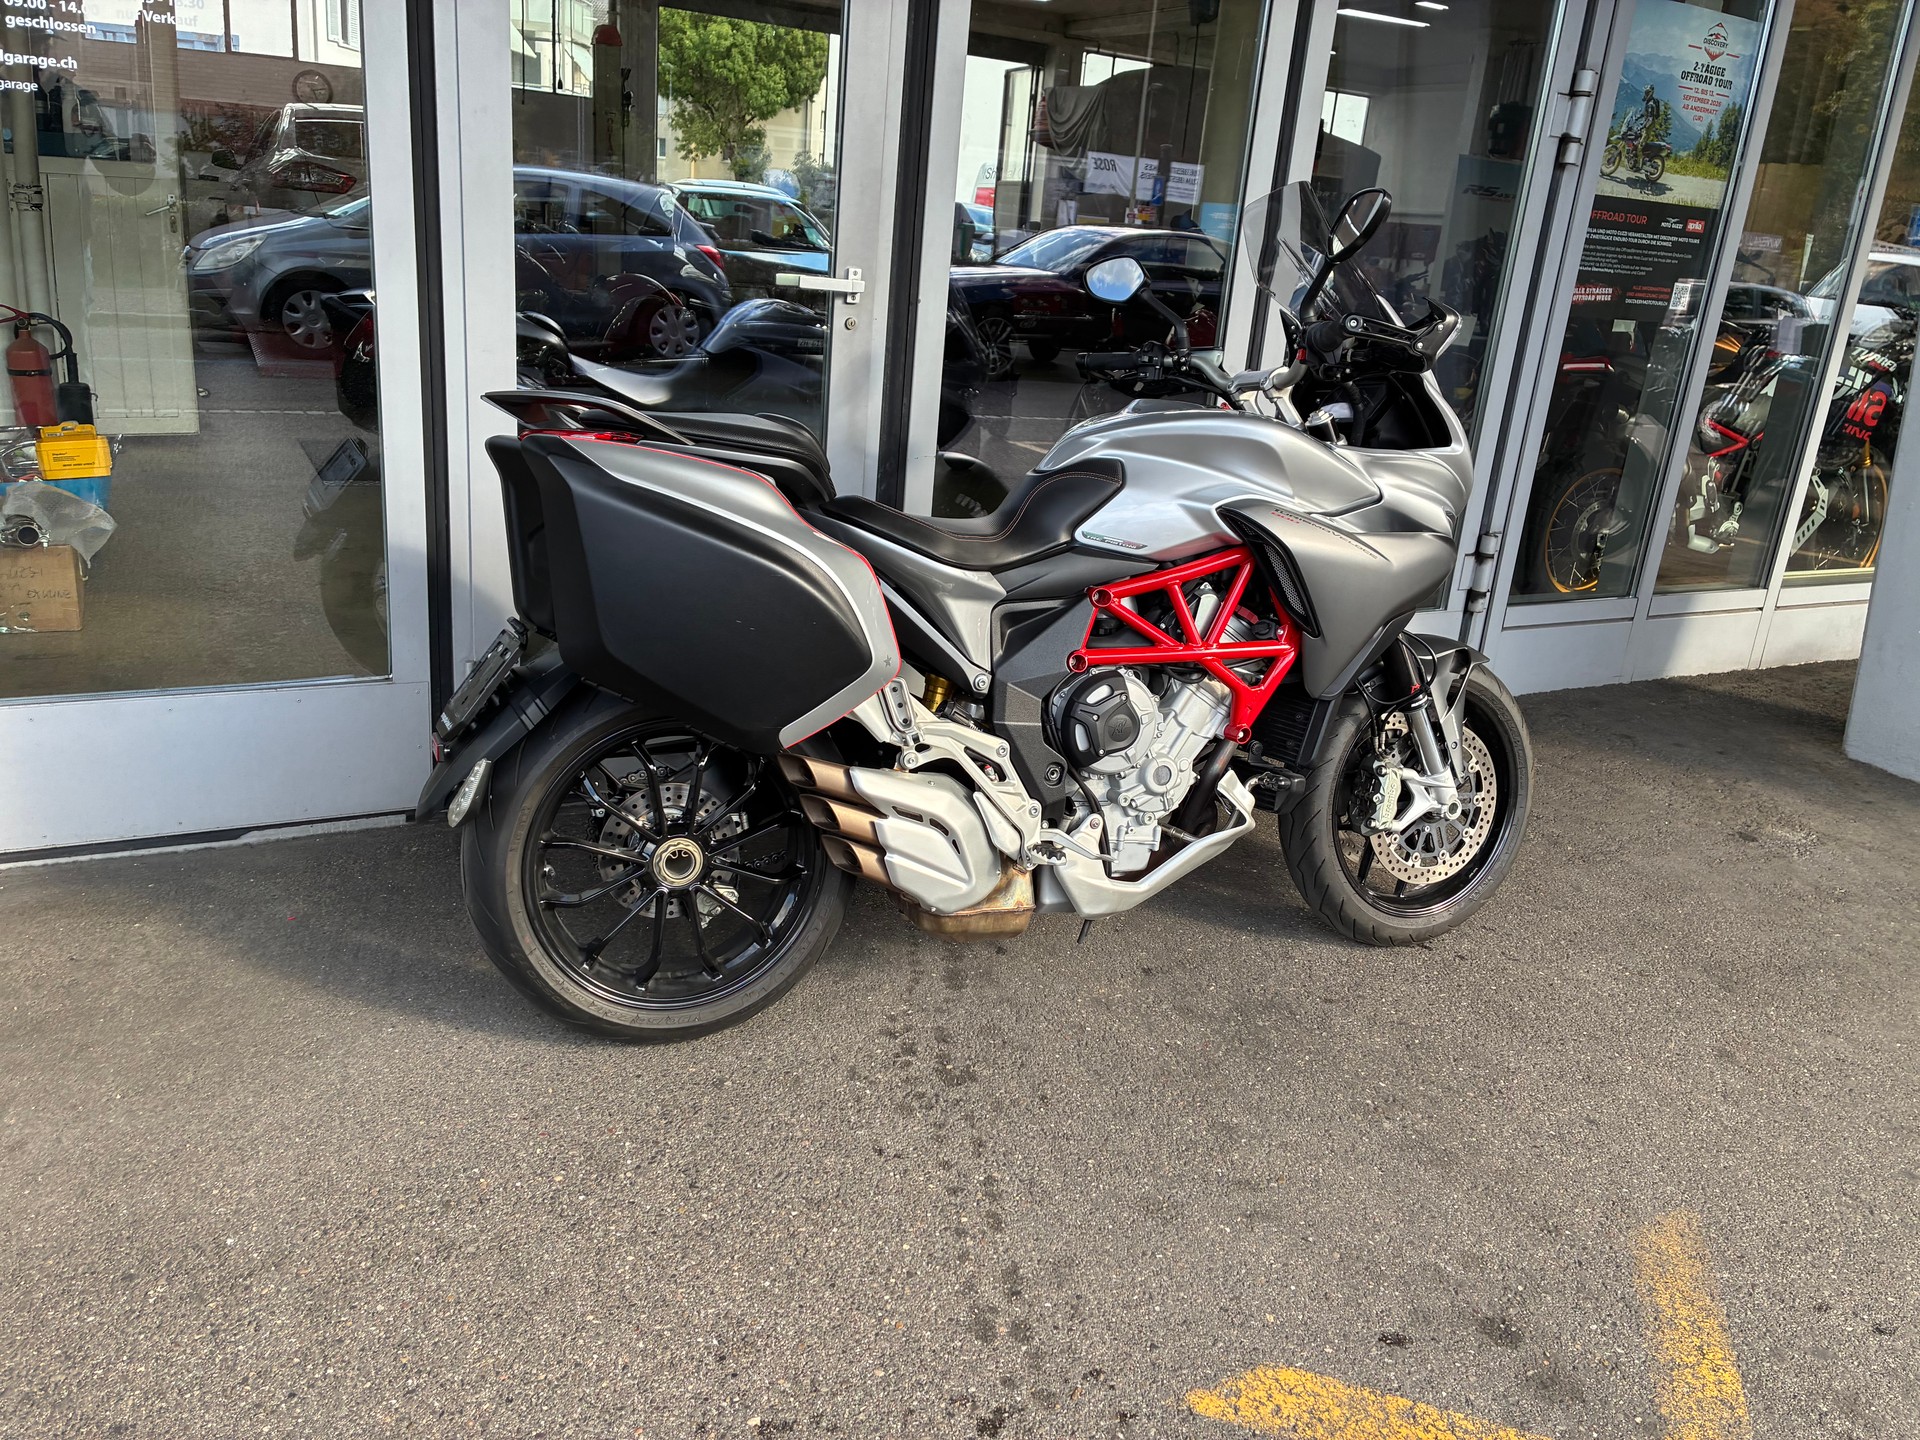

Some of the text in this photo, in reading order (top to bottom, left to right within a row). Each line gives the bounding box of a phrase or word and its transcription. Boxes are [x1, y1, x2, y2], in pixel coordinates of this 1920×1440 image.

[5, 15, 97, 35] geschlossen
[143, 10, 198, 27] Verkauf
[1703, 37, 1729, 49] DISCOVERY
[1680, 70, 1733, 90] OFFROAD TOUR
[1683, 94, 1710, 105] SEPTEMBER
[1690, 105, 1719, 116] ANDERMATT
[1591, 210, 1648, 225] FFROAD TOUR
[1688, 222, 1702, 232] aprilia
